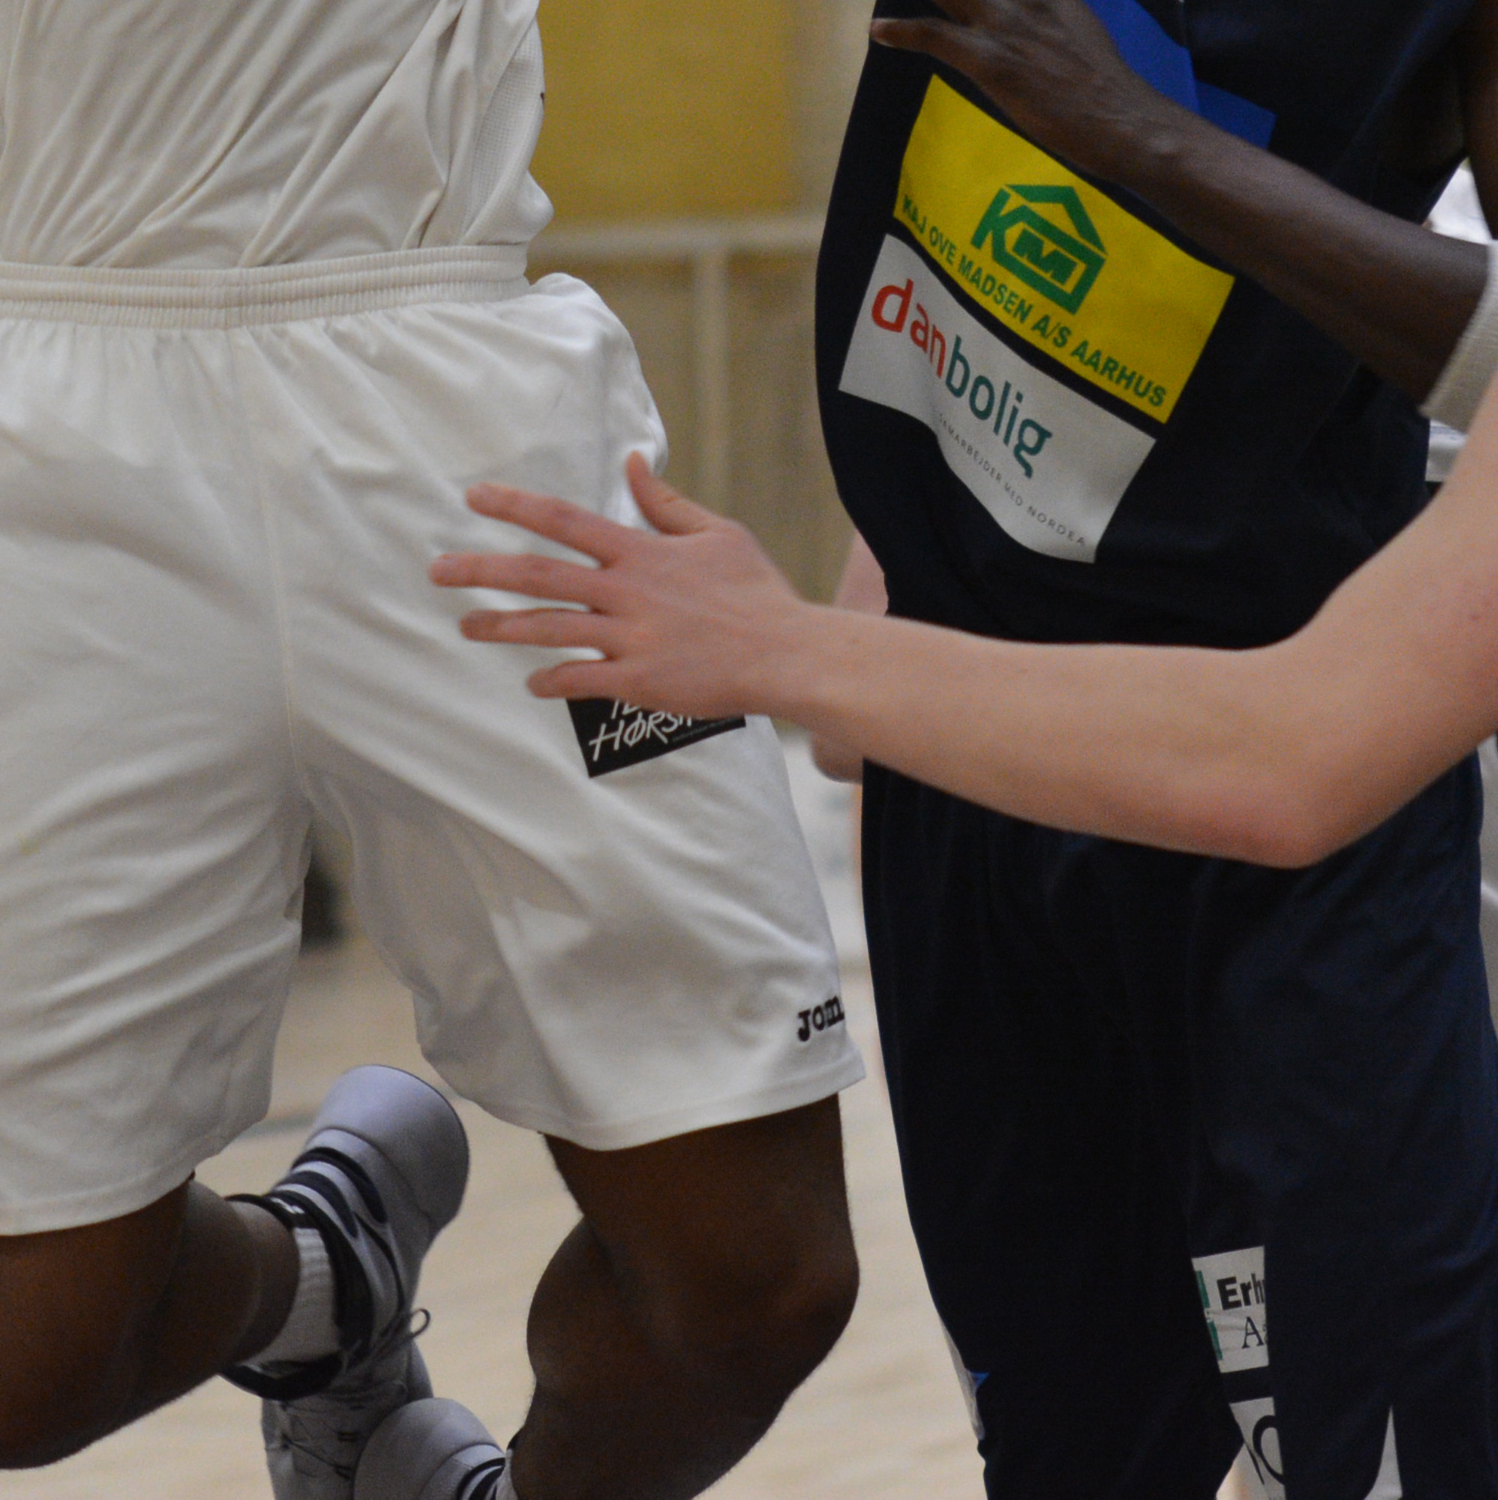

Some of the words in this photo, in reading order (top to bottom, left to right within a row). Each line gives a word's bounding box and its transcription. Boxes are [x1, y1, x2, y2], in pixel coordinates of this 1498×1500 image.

[870, 278, 1054, 480] danbolig
[928, 225, 958, 266] OVE
[957, 253, 1034, 324] MADSEN
[1031, 313, 1072, 348] A/S
[1070, 339, 1167, 407] AARHUS
[1026, 505, 1087, 547] NORDEA
